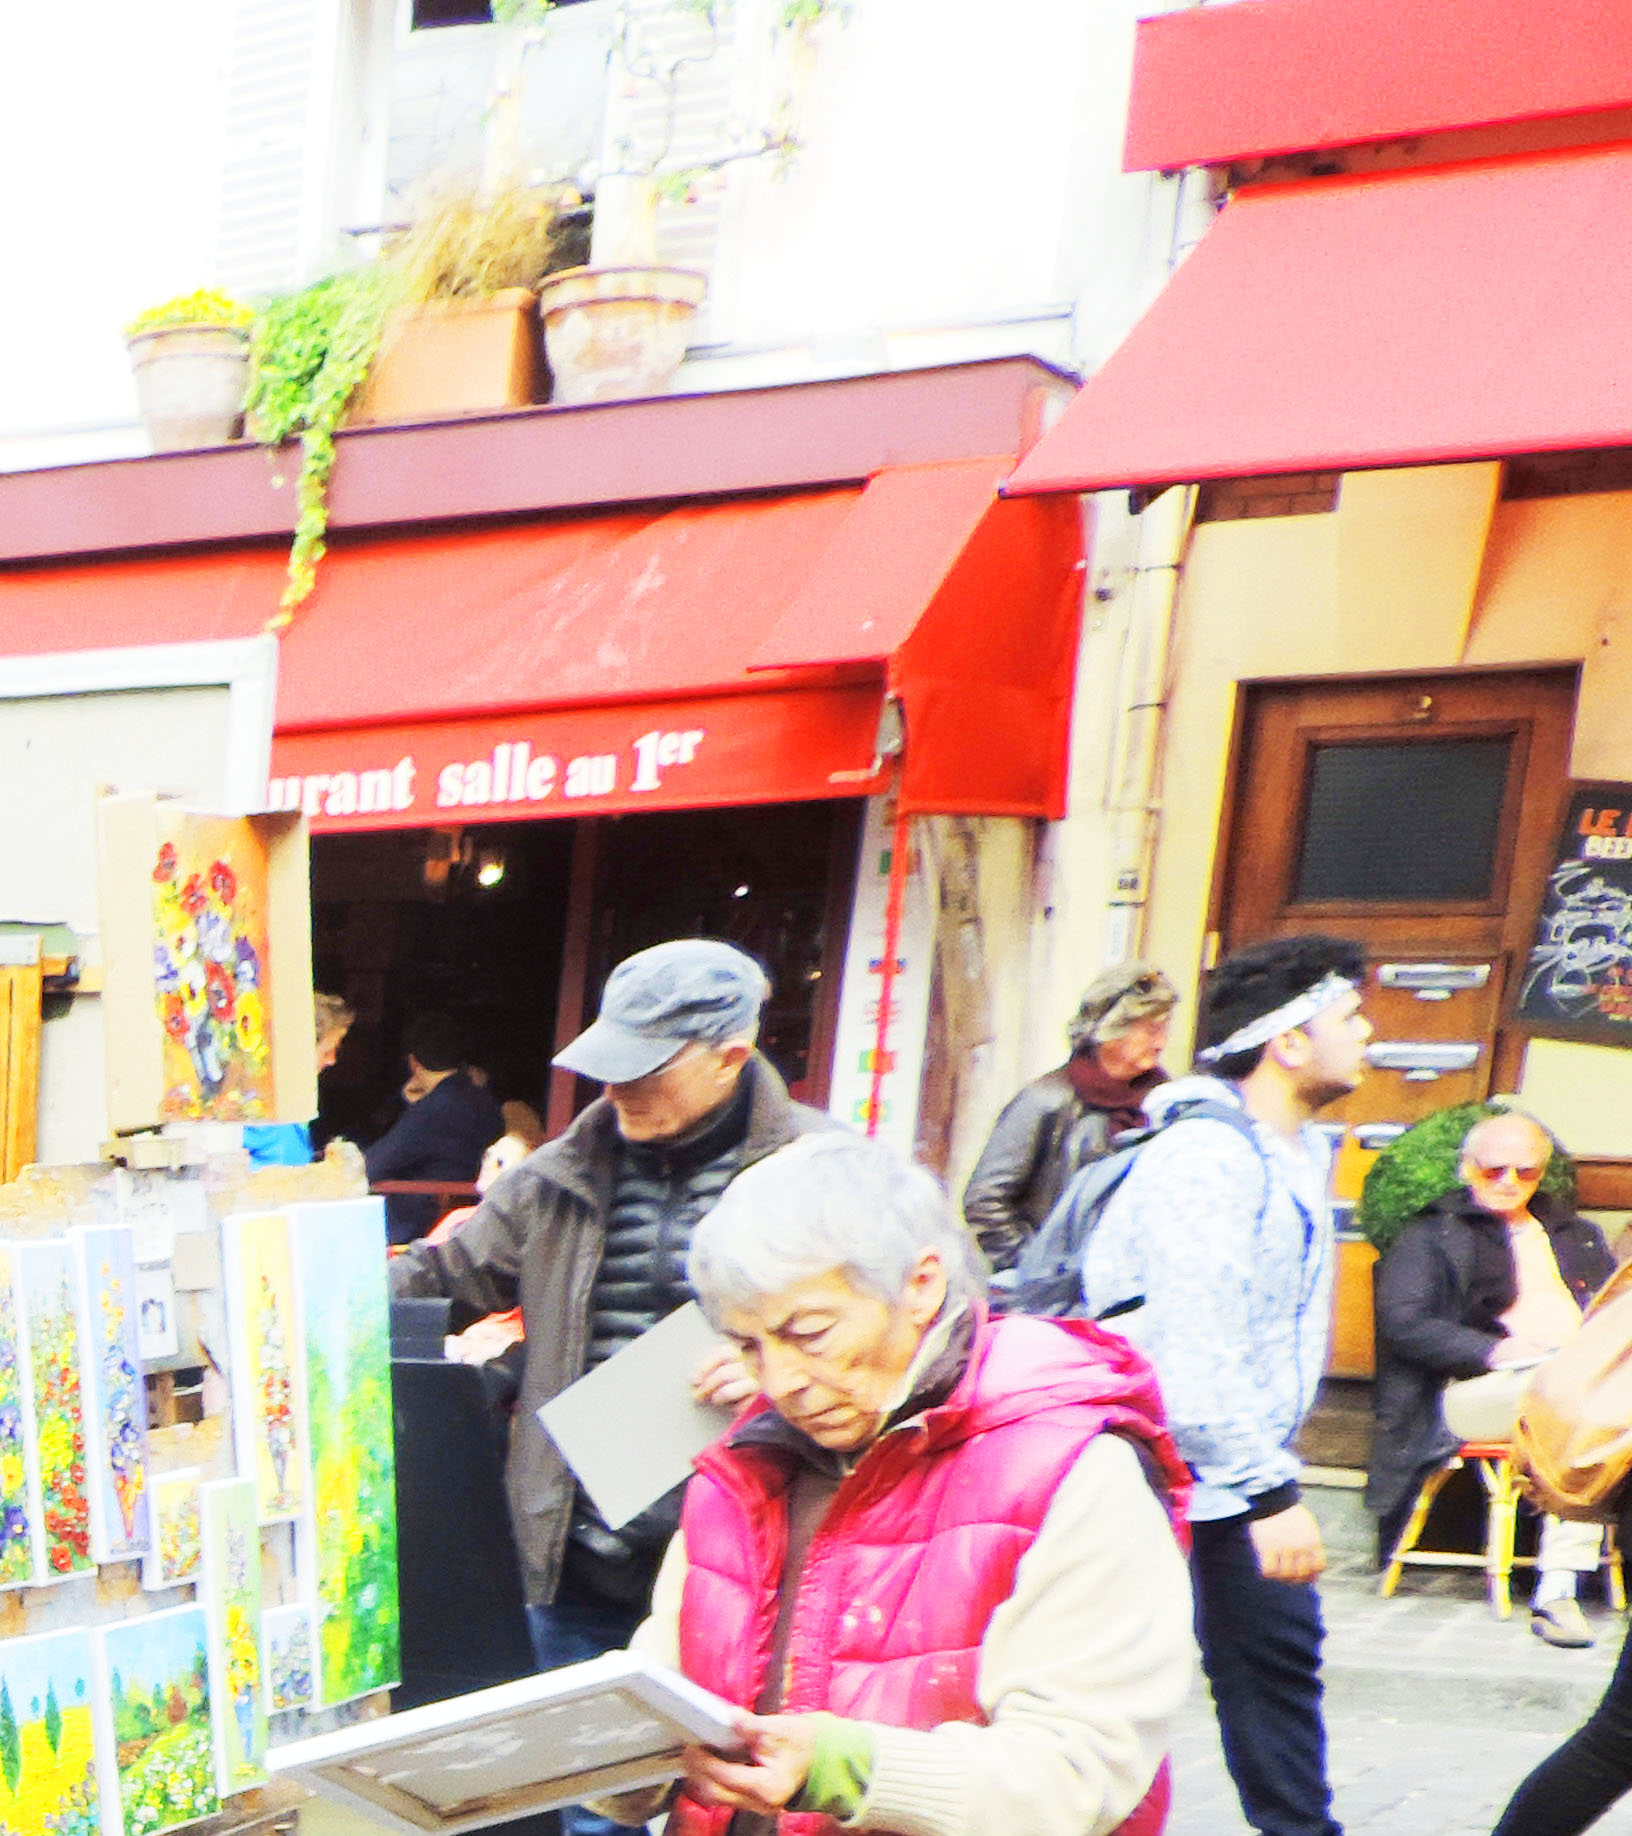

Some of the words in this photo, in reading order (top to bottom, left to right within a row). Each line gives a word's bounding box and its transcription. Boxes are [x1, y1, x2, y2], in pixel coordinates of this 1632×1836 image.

[436, 739, 559, 809] salle
[564, 753, 618, 798] au
[629, 728, 705, 793] 1er
[1579, 807, 1622, 837] LE
